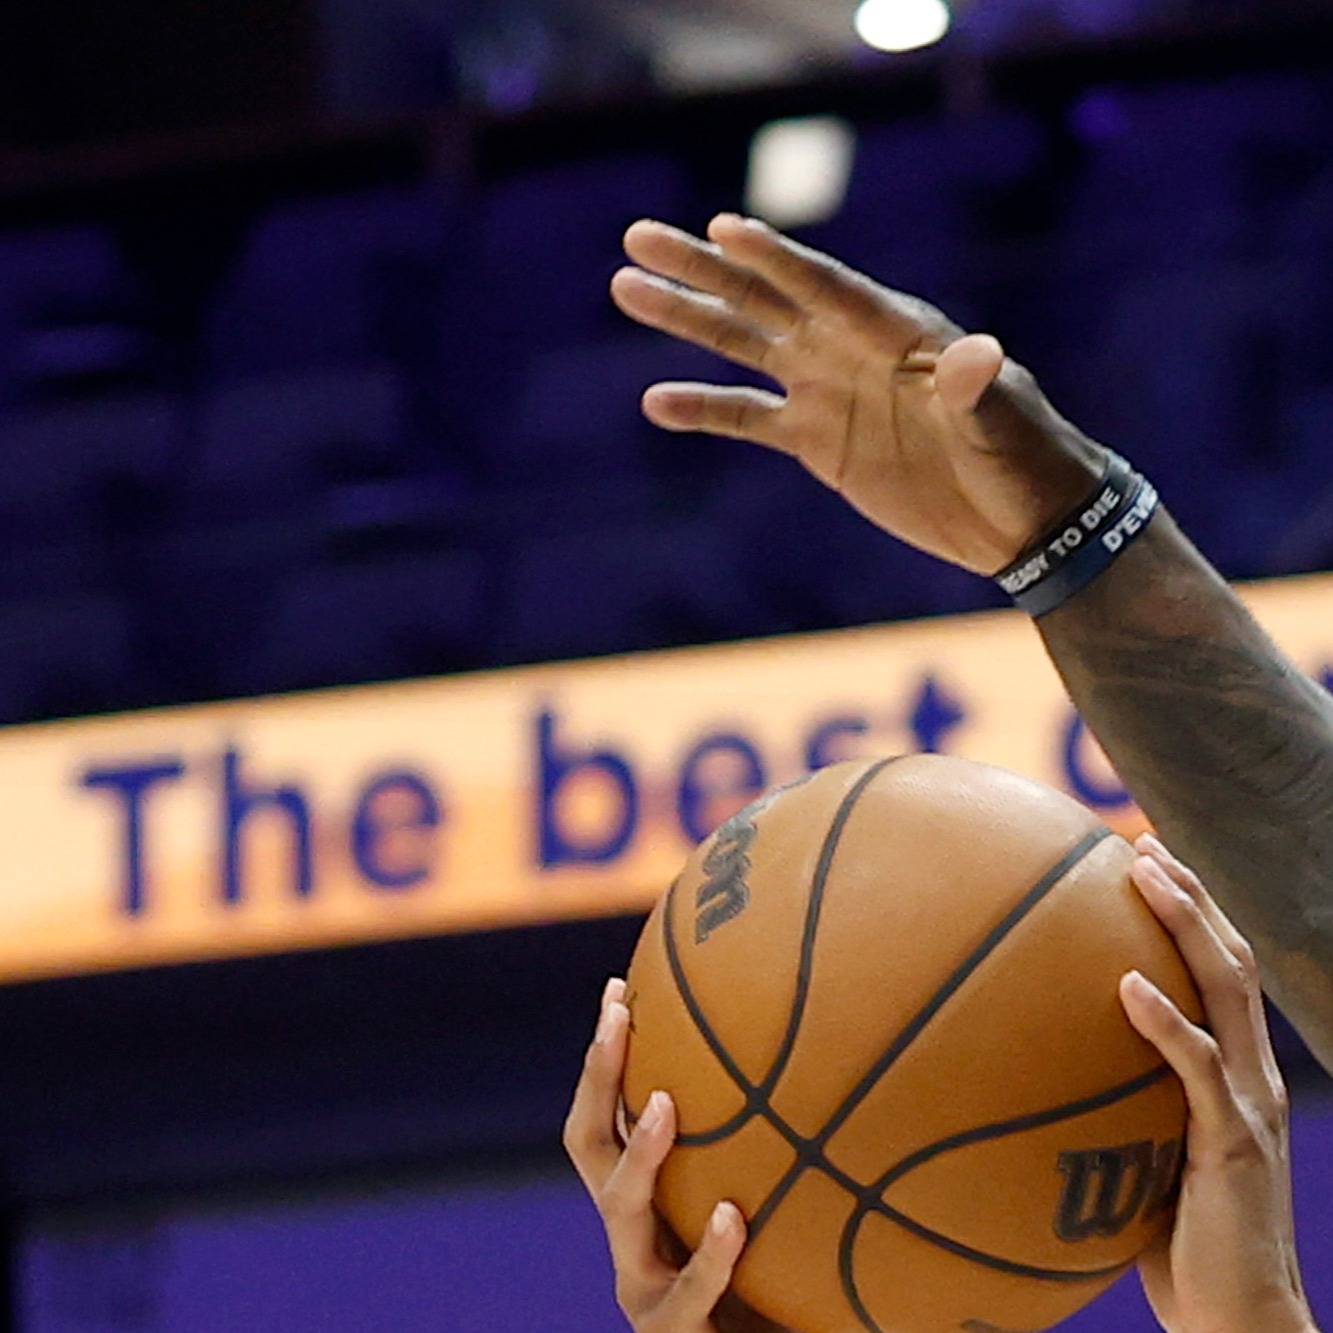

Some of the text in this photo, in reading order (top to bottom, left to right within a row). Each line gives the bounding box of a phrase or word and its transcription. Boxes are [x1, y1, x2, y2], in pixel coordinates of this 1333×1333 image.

[1050, 527, 1083, 556] TO
[1080, 486, 1121, 531] DIE
[82, 732, 448, 918] The
